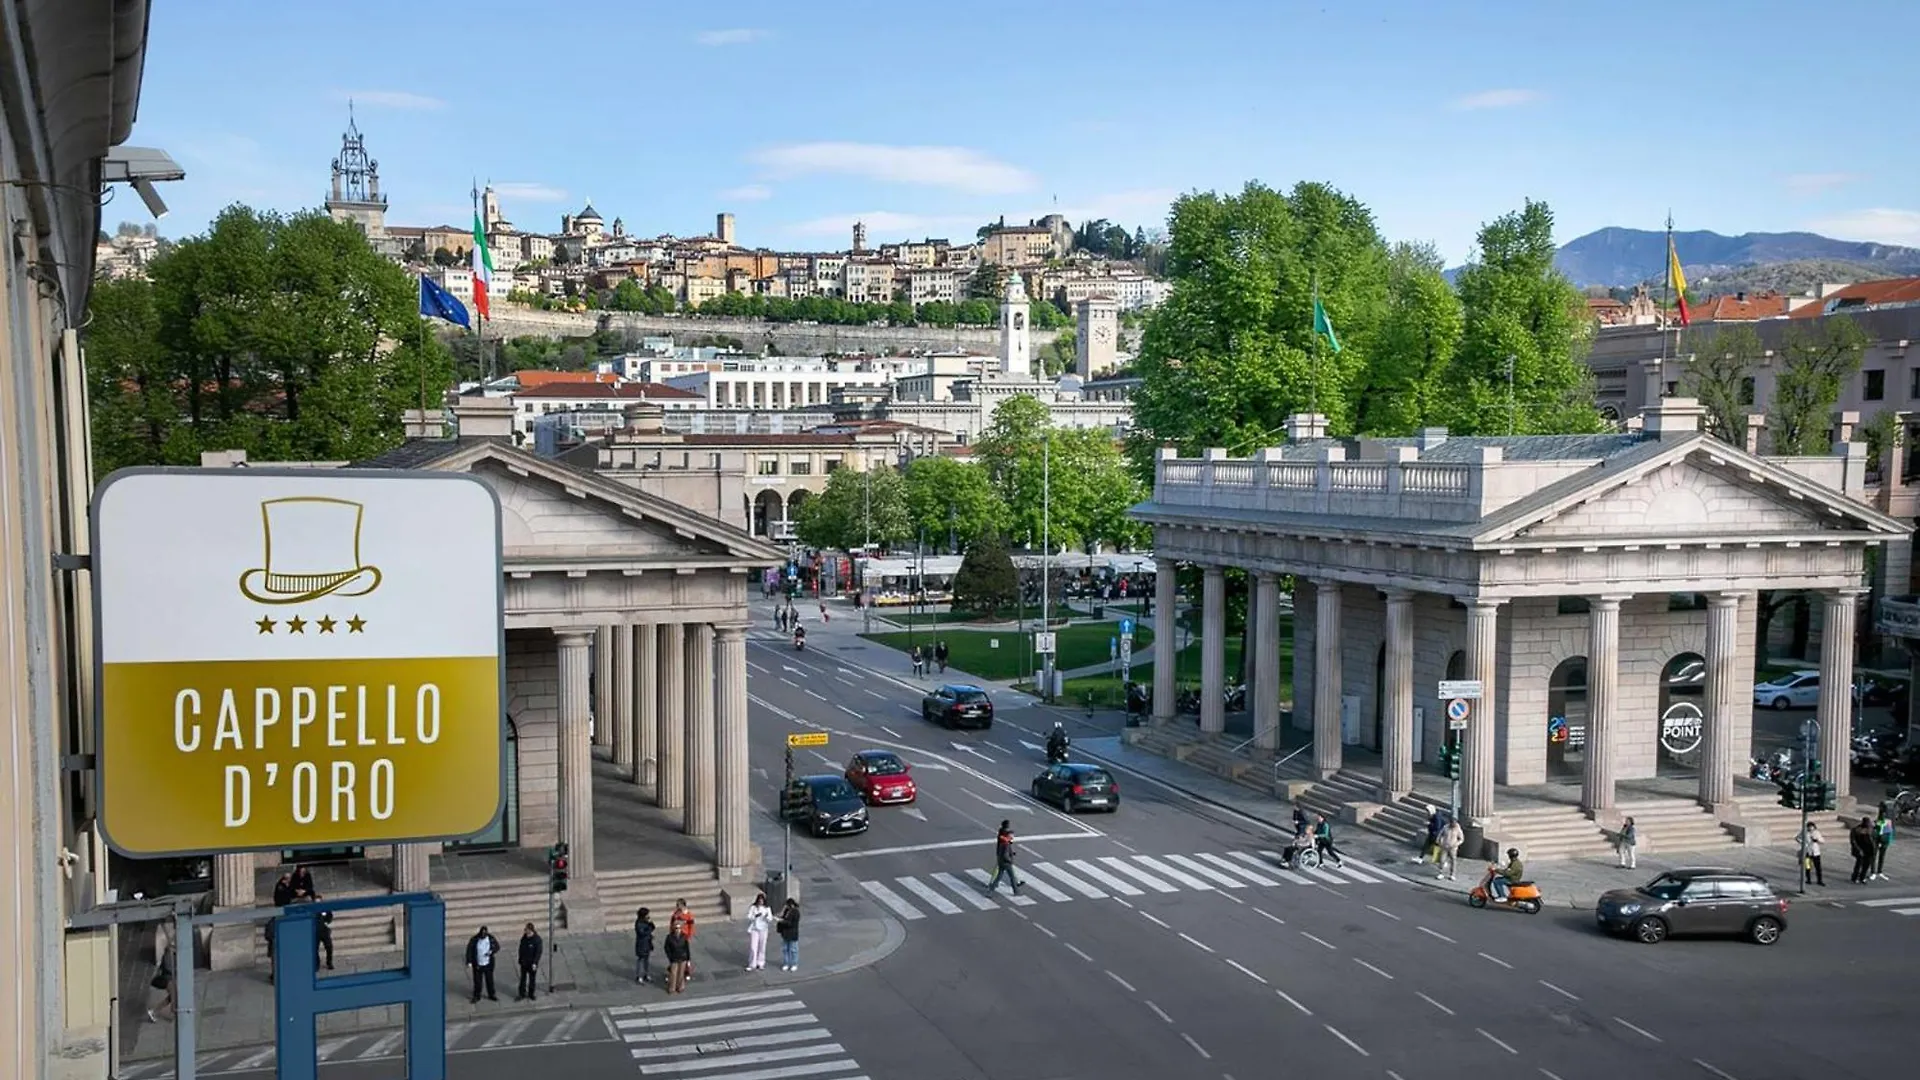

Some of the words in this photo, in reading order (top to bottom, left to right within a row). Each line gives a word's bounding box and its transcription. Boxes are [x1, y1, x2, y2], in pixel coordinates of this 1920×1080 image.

[174, 683, 440, 753] CAPPELLO
[1663, 726, 1702, 738] POINT
[224, 758, 395, 828] D'ORO
